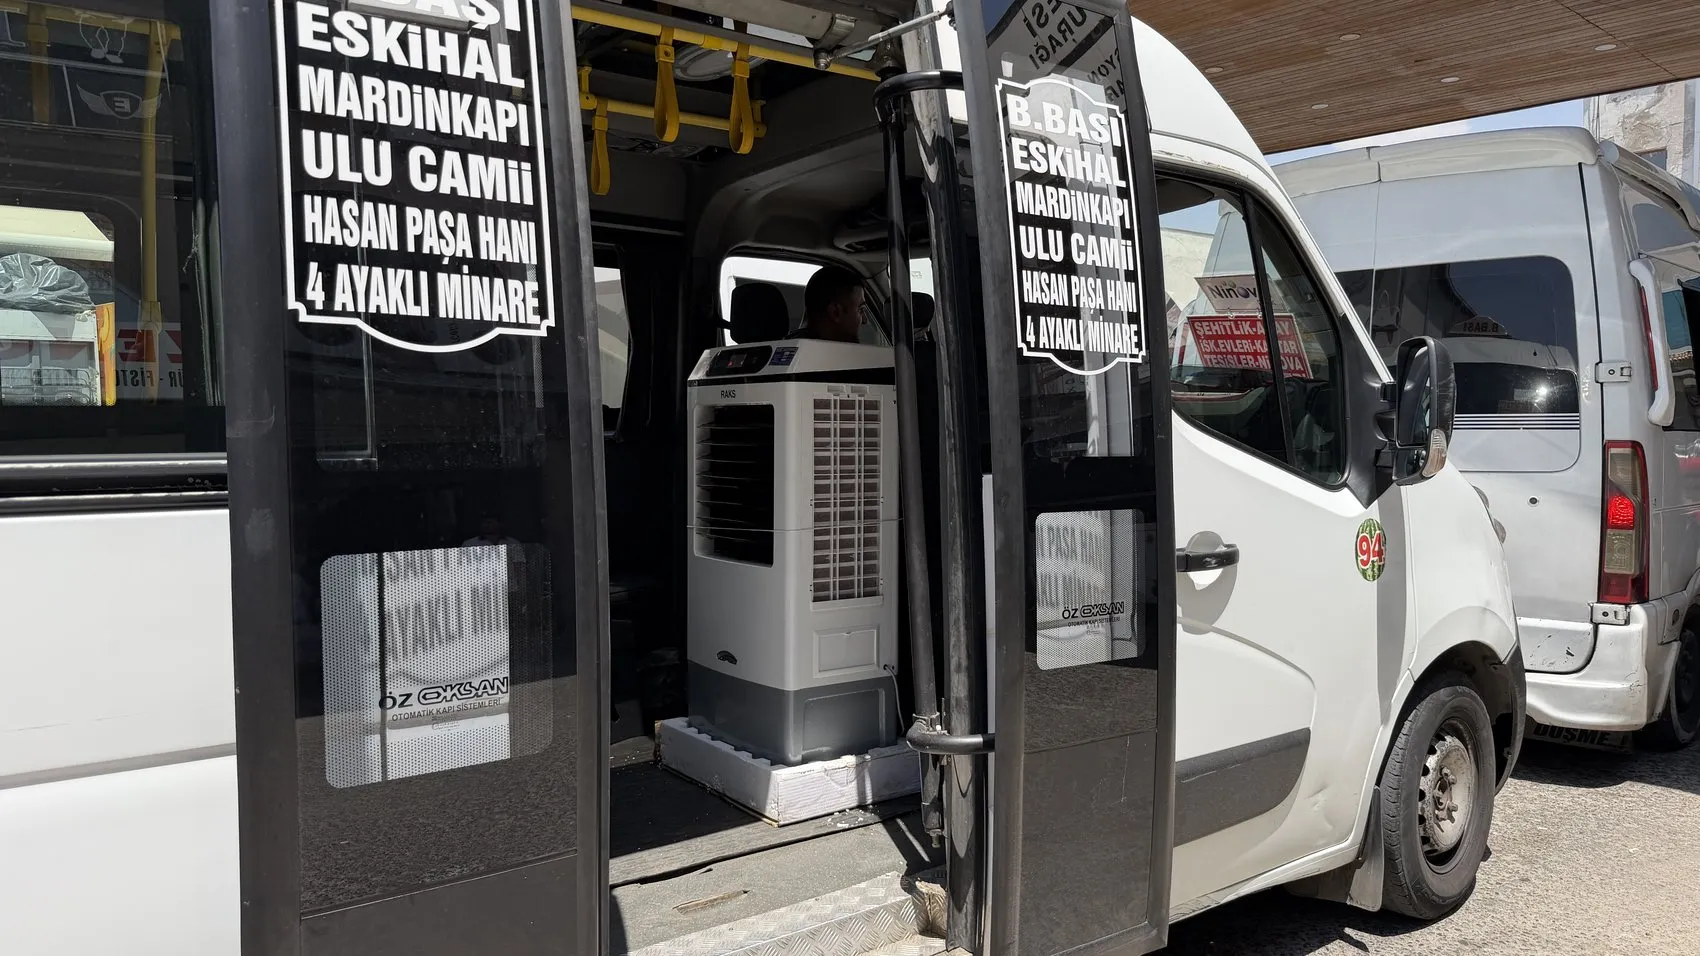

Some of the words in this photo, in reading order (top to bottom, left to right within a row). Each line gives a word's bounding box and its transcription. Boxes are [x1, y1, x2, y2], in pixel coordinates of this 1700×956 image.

[372, 0, 521, 31] AŞI
[302, 129, 392, 187] ULU
[304, 194, 398, 251] HASAN
[406, 206, 473, 264] PAŞA
[479, 215, 537, 264] HANI
[1019, 225, 1064, 262] ULU
[306, 261, 325, 310] 4
[334, 263, 429, 317] AYAKLI
[437, 265, 541, 325] MİNARE
[1022, 270, 1069, 307] HASAN
[1071, 275, 1105, 315] PAŞA
[1106, 279, 1137, 313] HANI
[1207, 282, 1258, 299] Ninov
[1026, 315, 1036, 348] 4
[1039, 315, 1085, 351] AYAKLI
[1087, 315, 1140, 355] MİNARE
[720, 389, 736, 399] RAKS
[1358, 531, 1385, 568] 94
[1062, 607, 1078, 620] ÖZ
[1080, 602, 1124, 618] OKSAN
[378, 690, 413, 711] ÖZ
[417, 676, 509, 705] OKSAN
[391, 707, 435, 722] OTOMATİK
[435, 705, 456, 717] KAPI
[456, 698, 502, 712] SİSTEMLERİ
